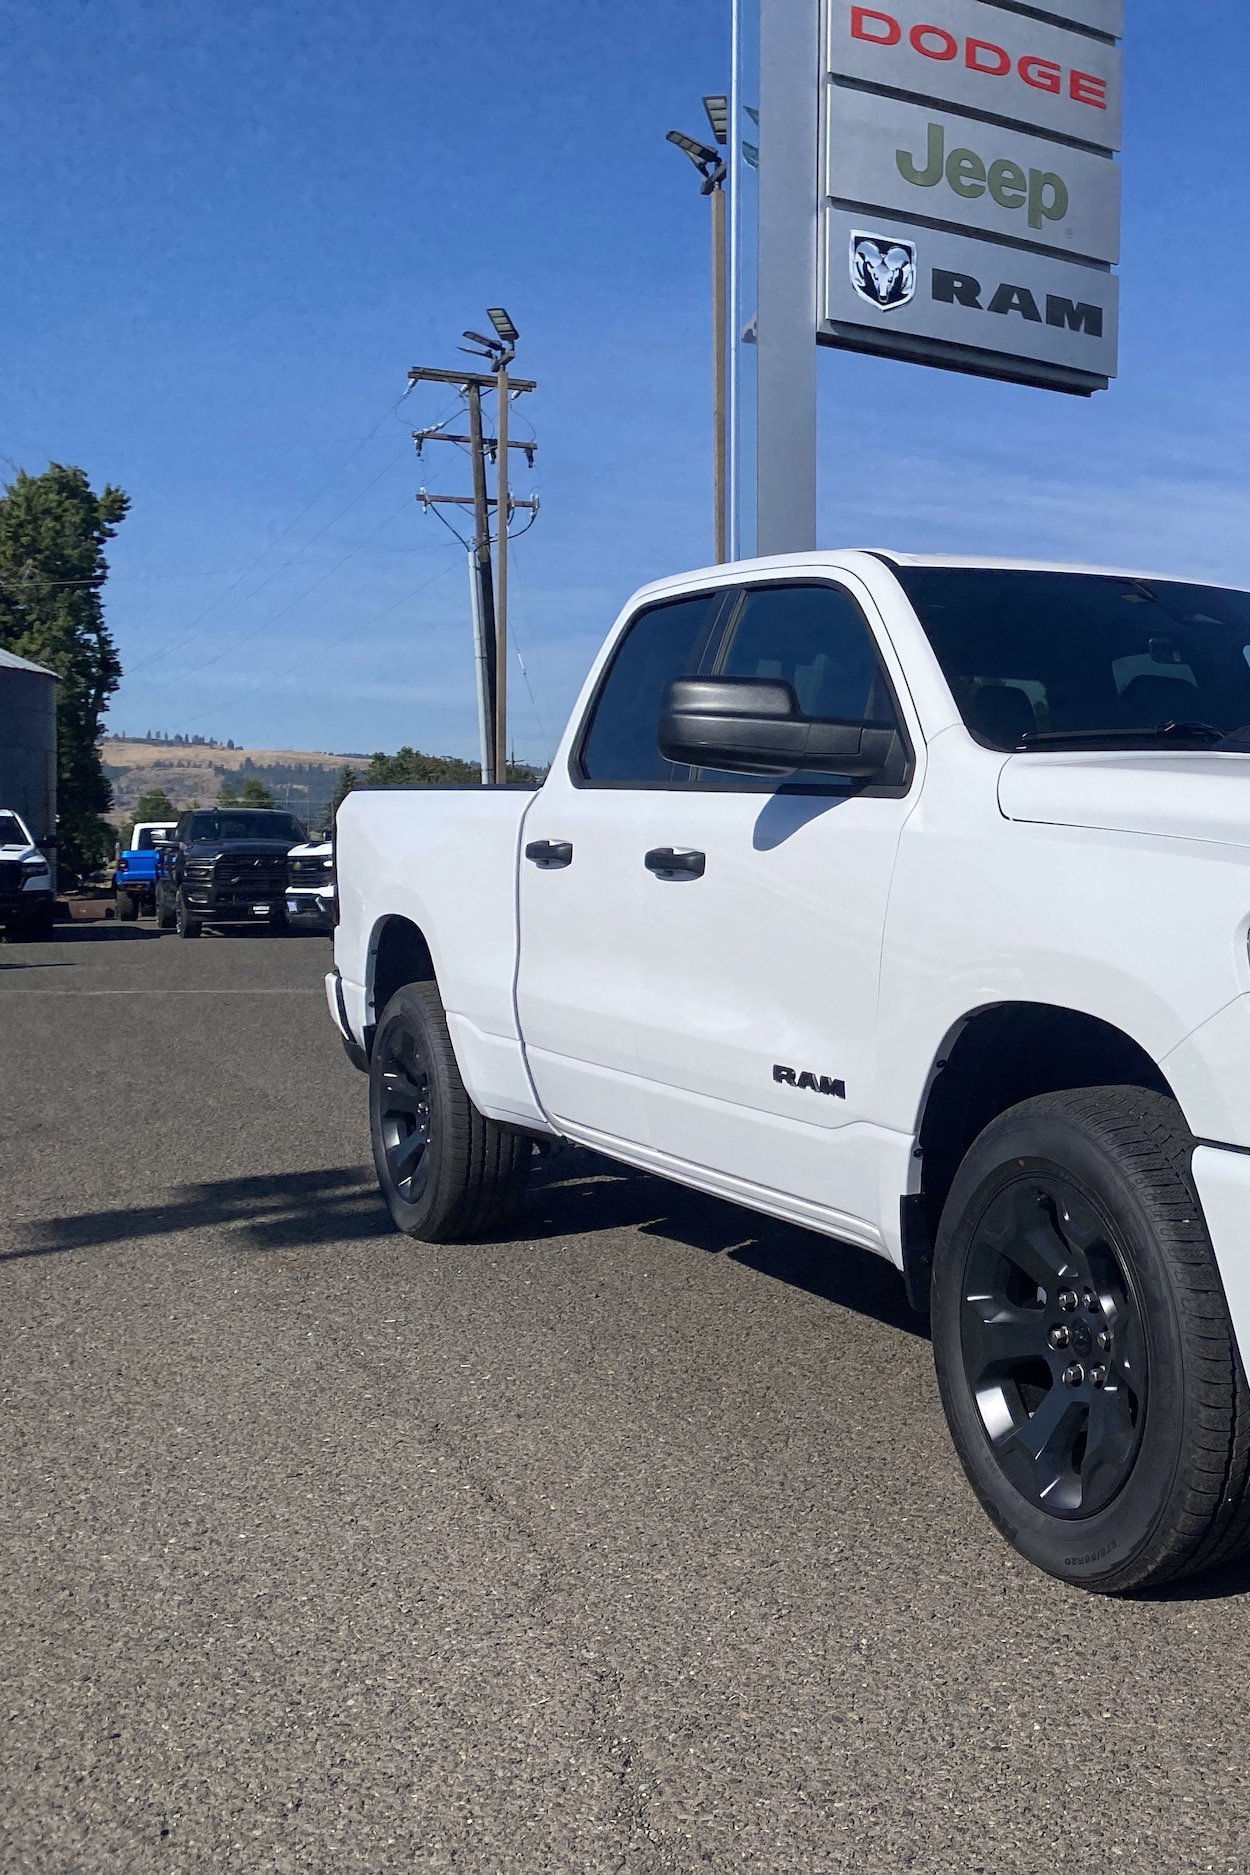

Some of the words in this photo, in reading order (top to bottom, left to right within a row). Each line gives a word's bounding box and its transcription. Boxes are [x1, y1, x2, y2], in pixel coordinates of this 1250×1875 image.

[851, 6, 1107, 109] DODGE
[896, 123, 1069, 229] Jeep
[931, 268, 1103, 338] RAM
[773, 1064, 846, 1100] RAM
